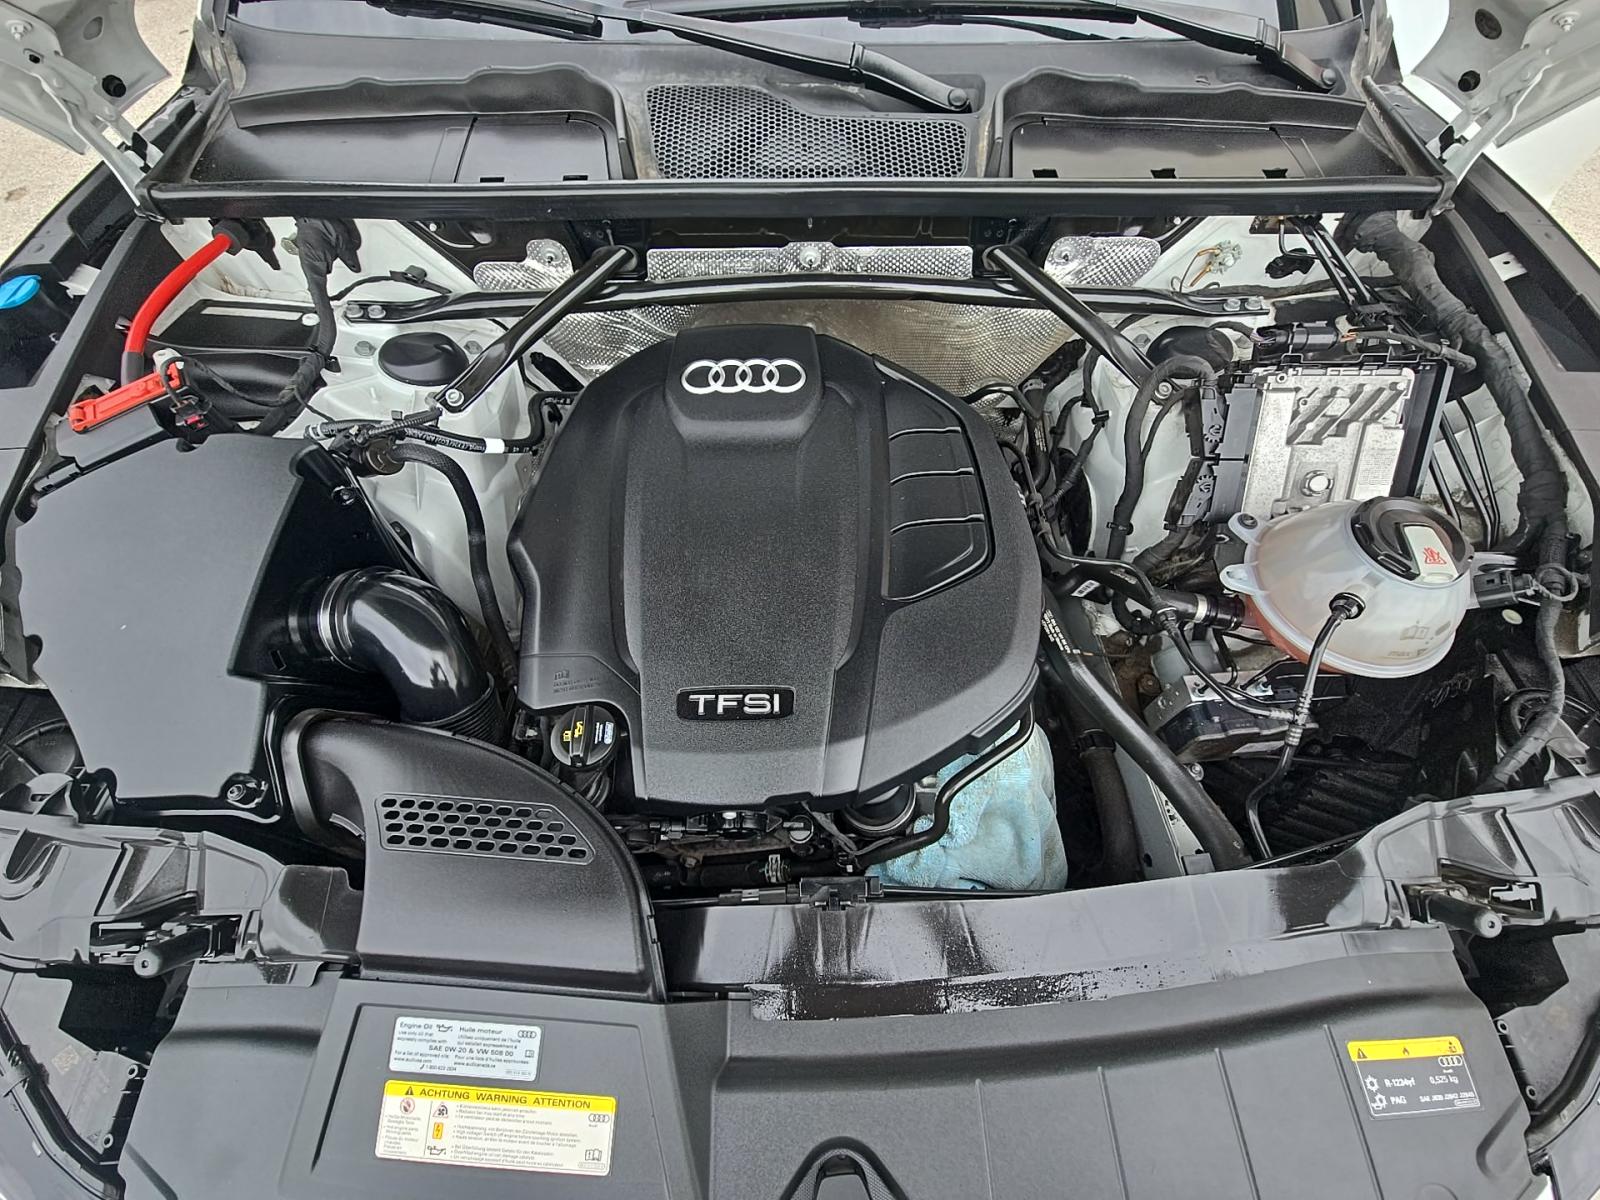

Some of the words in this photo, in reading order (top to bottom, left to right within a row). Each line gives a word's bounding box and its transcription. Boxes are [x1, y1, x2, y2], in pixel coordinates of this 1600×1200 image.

[688, 693, 781, 716] TFSI
[1383, 1077, 1417, 1089] R-1234yf
[1429, 1075, 1449, 1085] 0,525
[1449, 1074, 1459, 1084] kg
[419, 1088, 470, 1100] ACHTUNG
[475, 1092, 527, 1104] WARNING
[533, 1097, 591, 1109] ATTENTION
[1389, 1095, 1408, 1105] PAG
